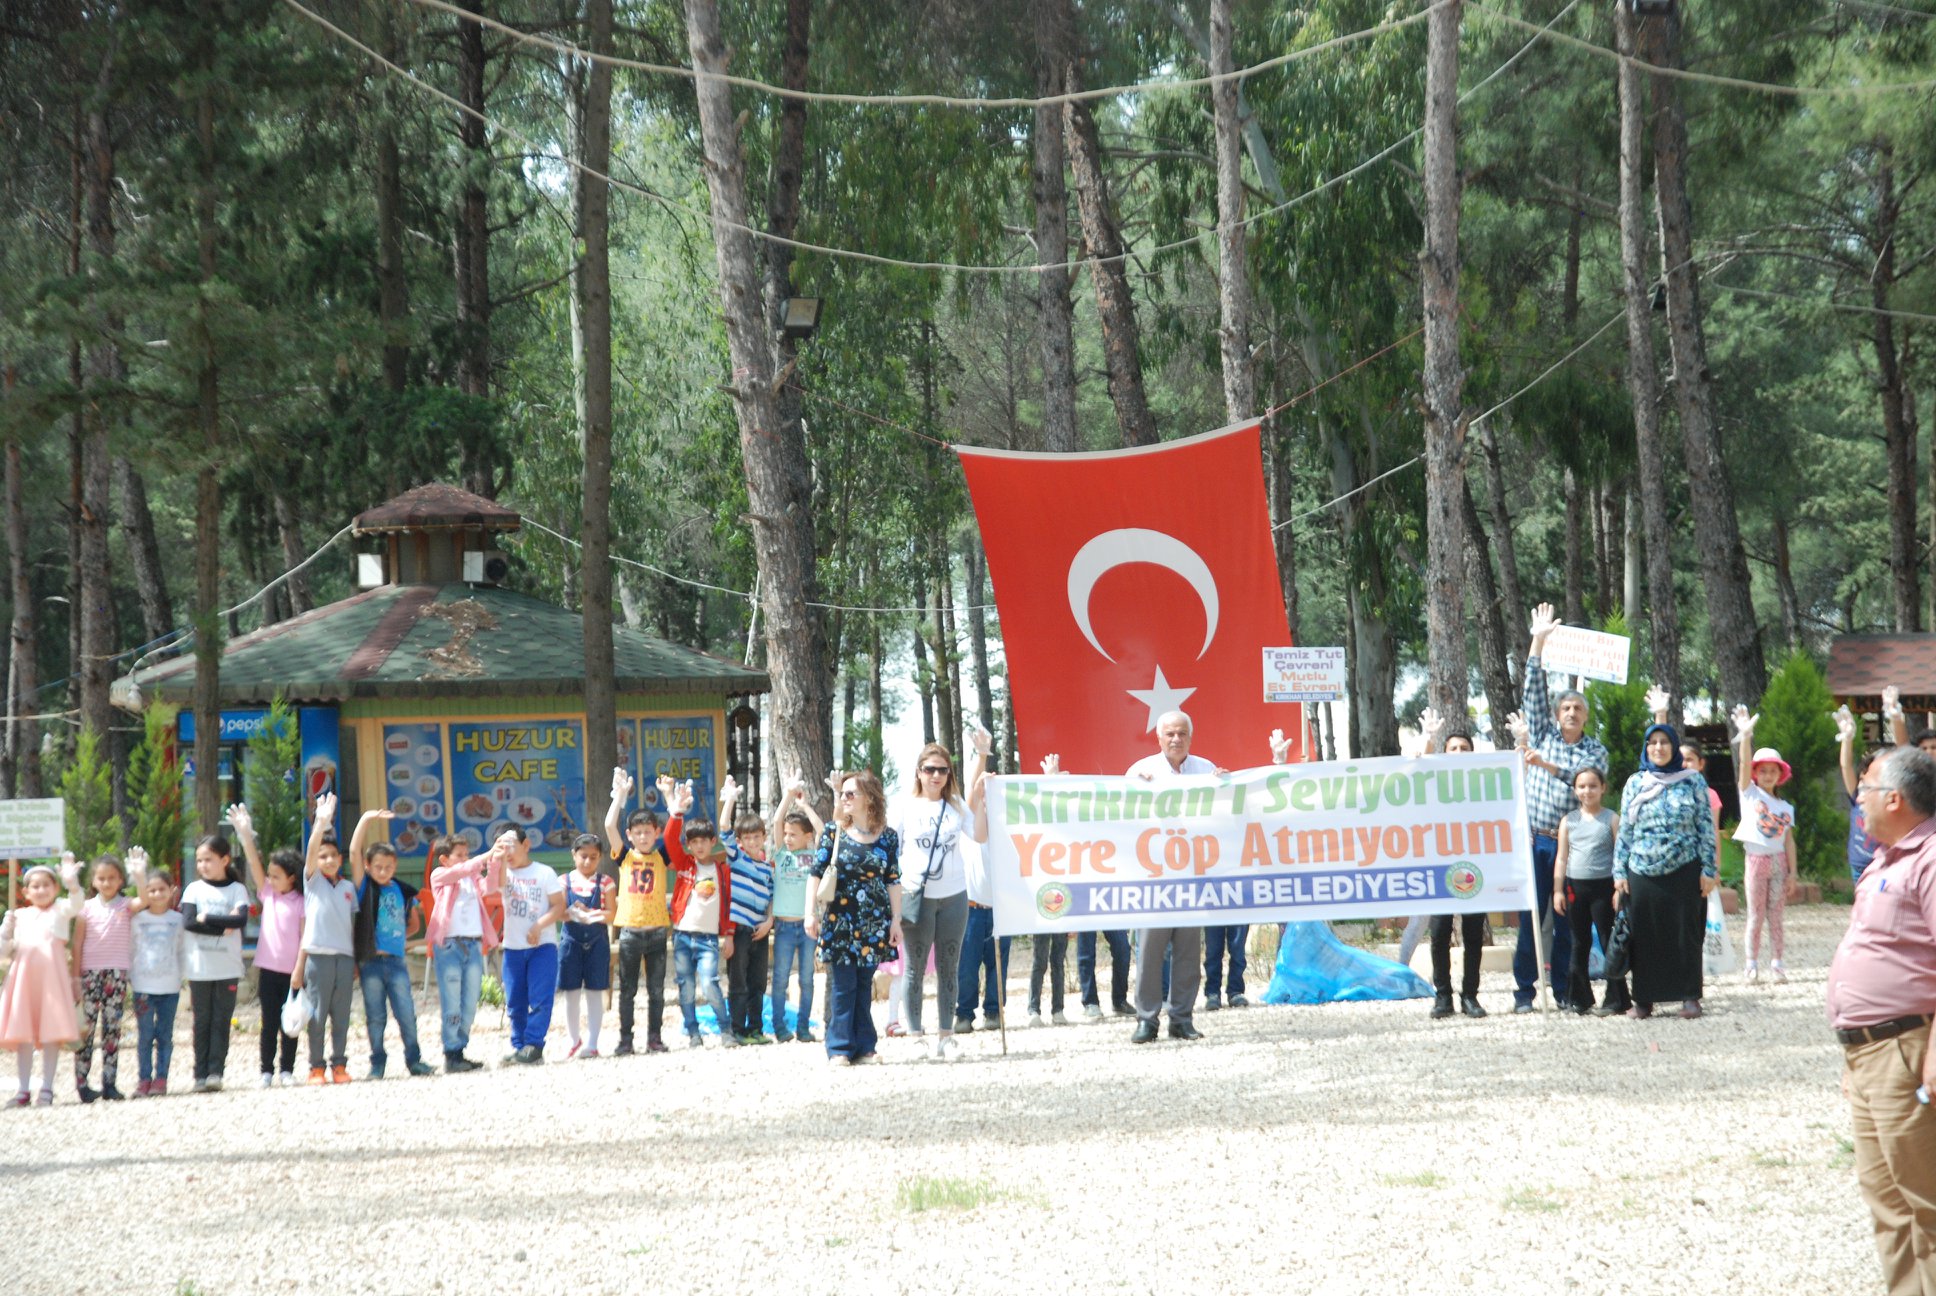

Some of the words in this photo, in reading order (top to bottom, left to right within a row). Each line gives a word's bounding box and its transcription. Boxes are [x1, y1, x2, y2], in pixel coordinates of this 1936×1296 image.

[1264, 650, 1309, 660] Temiz
[1315, 649, 1342, 659] Tut
[1274, 660, 1333, 672] Çevreni
[1267, 682, 1286, 692] Et
[1292, 682, 1341, 692] Evreni
[1281, 671, 1327, 681] Mutlu
[456, 727, 576, 752] HUZUR
[644, 727, 710, 750] HUZUR
[473, 759, 558, 783] CAFE
[655, 758, 702, 779] CAFE
[1262, 766, 1514, 814] Seviyorum
[1010, 833, 1117, 877] Yere
[1136, 827, 1220, 878] Çöp
[1240, 819, 1513, 867] Atmıyorum
[628, 868, 655, 894] 19
[1089, 880, 1243, 912] KIRIKHAN
[1253, 870, 1436, 905] BELEDİYESİ
[511, 898, 527, 918] 98
